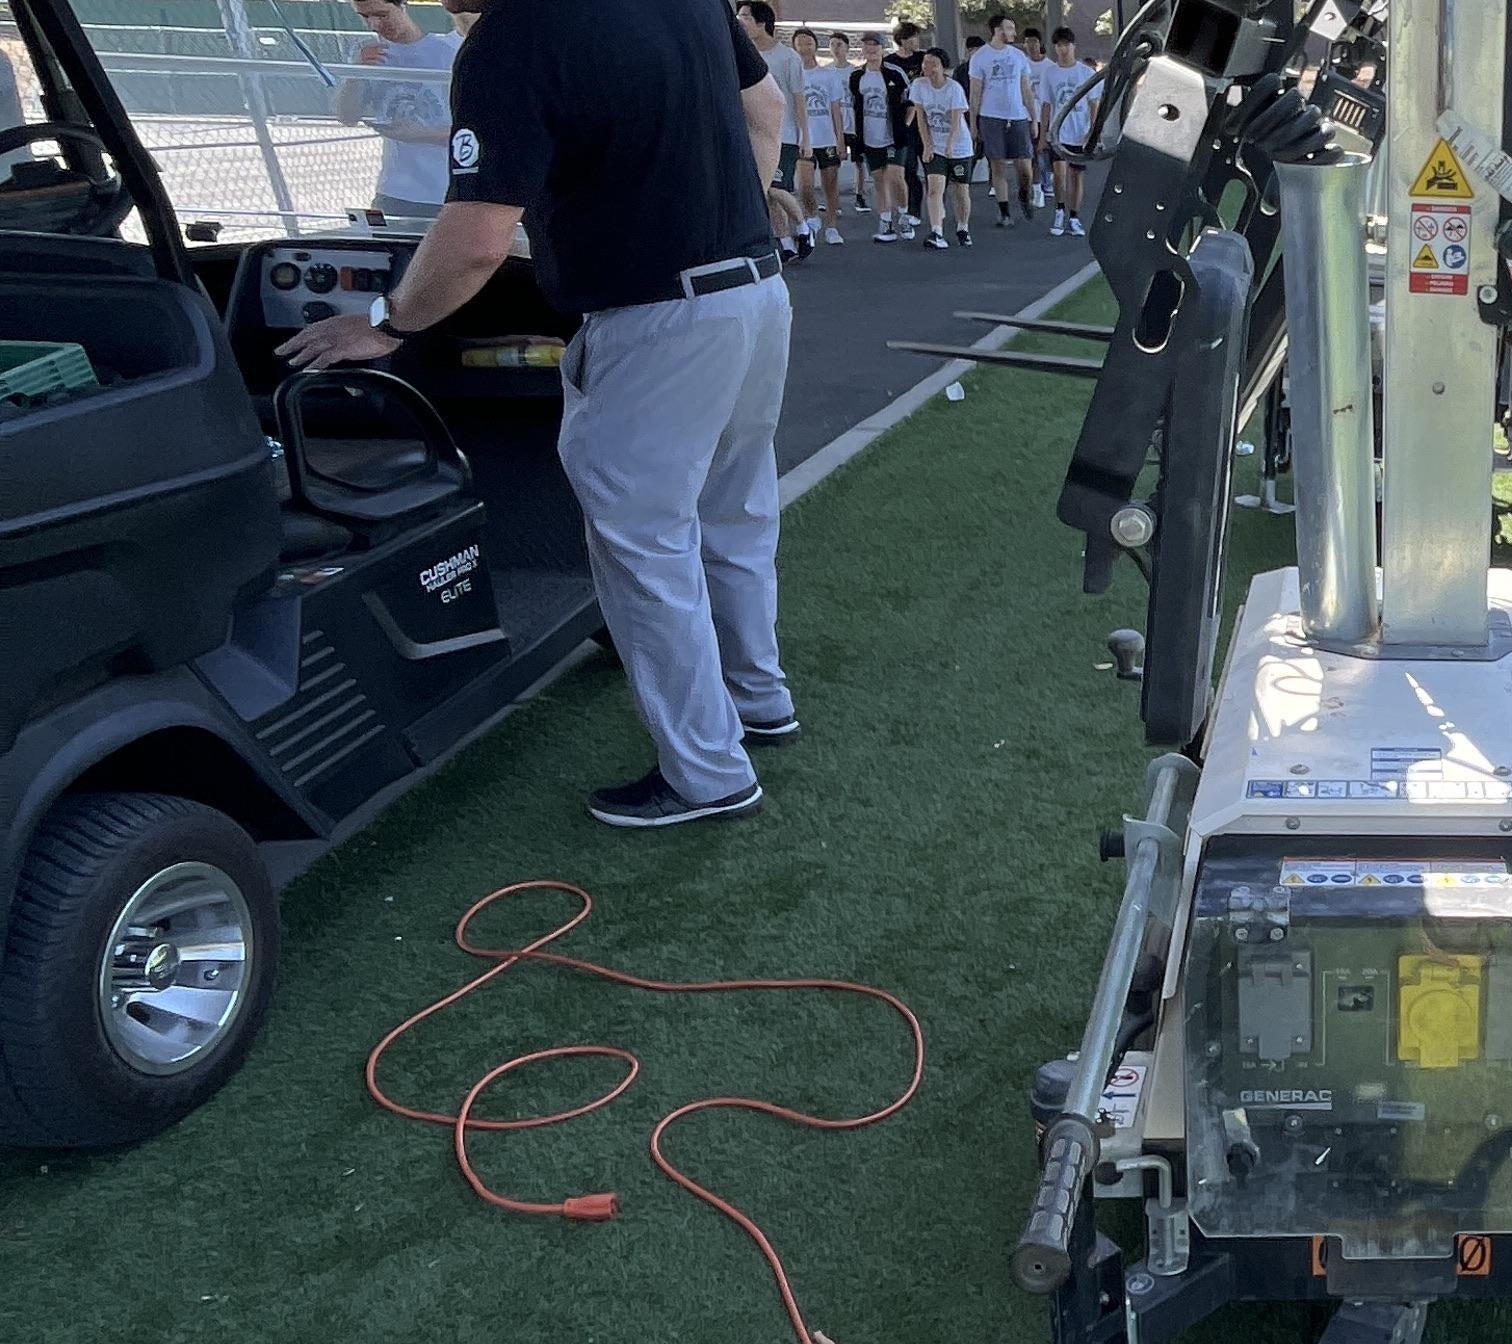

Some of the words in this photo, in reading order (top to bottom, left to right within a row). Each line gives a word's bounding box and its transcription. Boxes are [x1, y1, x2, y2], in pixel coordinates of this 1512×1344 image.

[420, 544, 480, 586] CUSHMAN
[441, 577, 472, 604] ELITE
[1240, 1089, 1333, 1103] GENERAC
